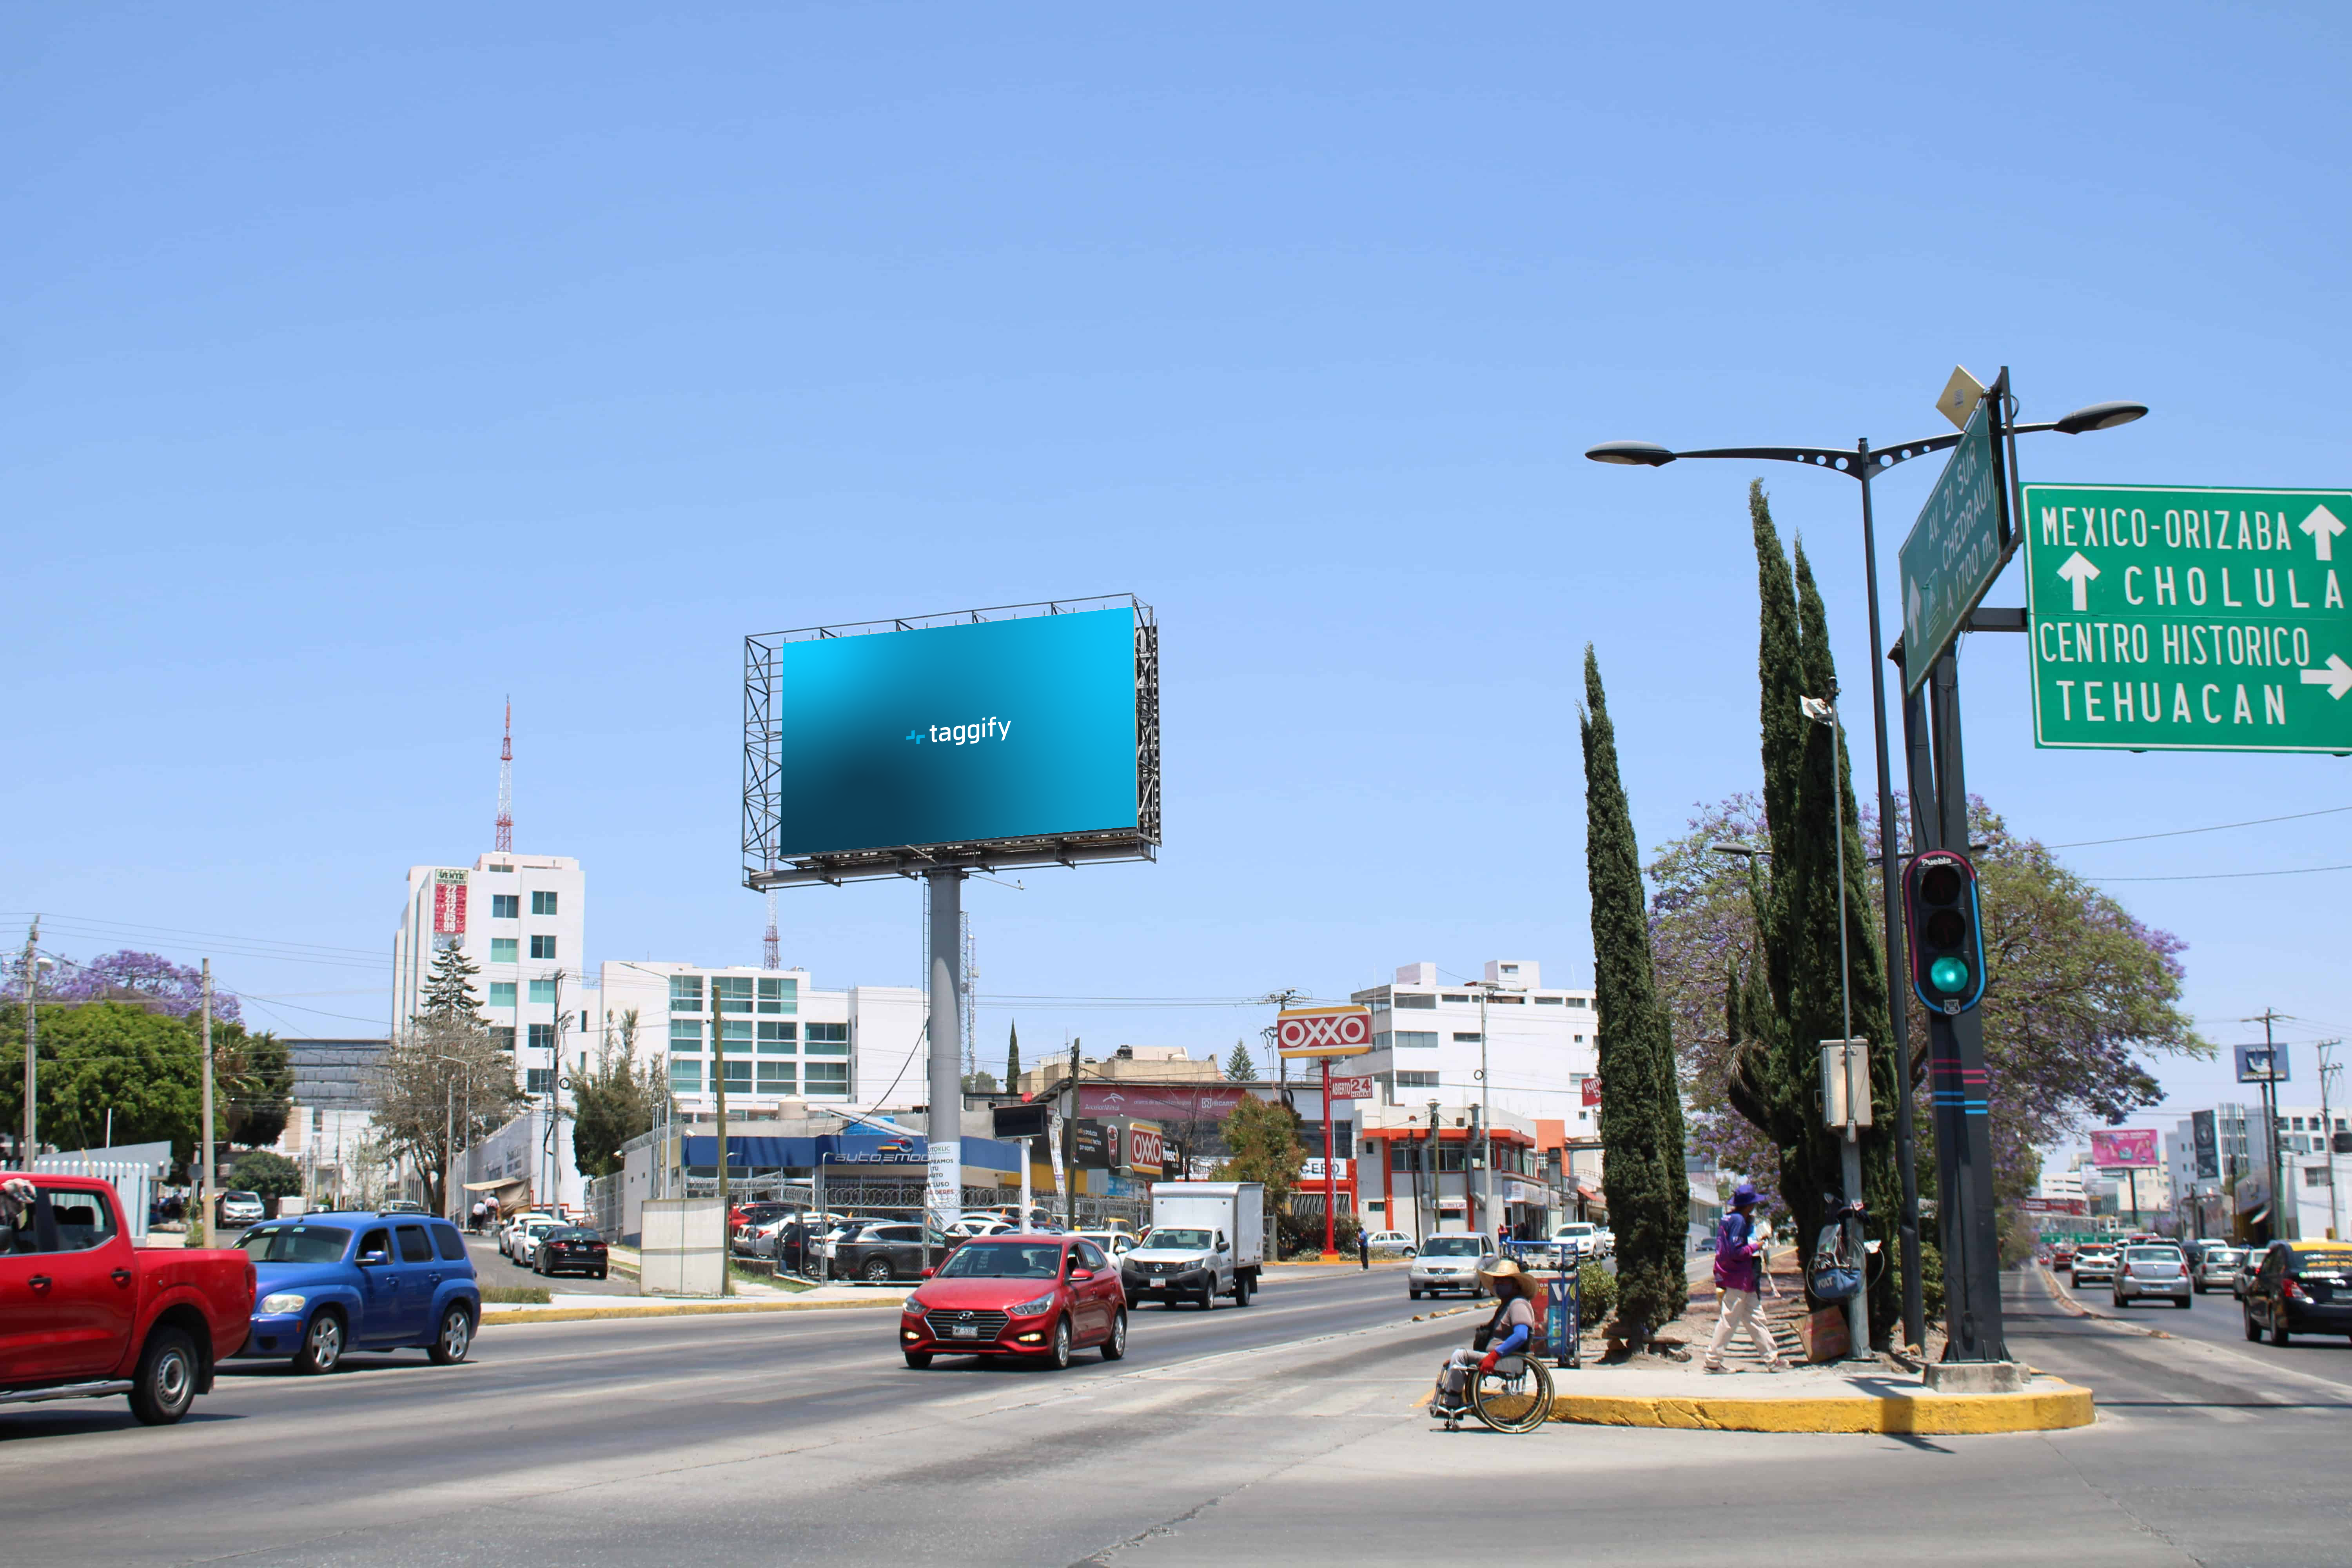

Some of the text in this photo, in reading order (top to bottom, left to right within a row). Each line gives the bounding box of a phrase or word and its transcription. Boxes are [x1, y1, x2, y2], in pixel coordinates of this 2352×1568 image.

[1928, 440, 1977, 550] AV. 21 SUR
[1942, 469, 1991, 571] CHEDRAUI
[2041, 506, 2292, 550] MEXICO-ORIZABA
[1947, 584, 1954, 618] A
[1956, 543, 1979, 602] 1700
[2124, 566, 2345, 609] CHOLULA
[2040, 622, 2310, 667] CENTRO HISTORICO
[2056, 680, 2286, 725] TEHUACAN
[929, 716, 1011, 746] taggify
[439, 871, 464, 880] VENTA
[1922, 857, 1951, 866] Puebla
[445, 884, 457, 894] 22
[443, 913, 456, 922] 05
[445, 903, 456, 913] 12
[443, 922, 456, 932] 99
[1281, 1016, 1365, 1048] OXXO
[1333, 1079, 1370, 1095] ABIERTO 24
[1133, 1134, 1161, 1164] OXXO
